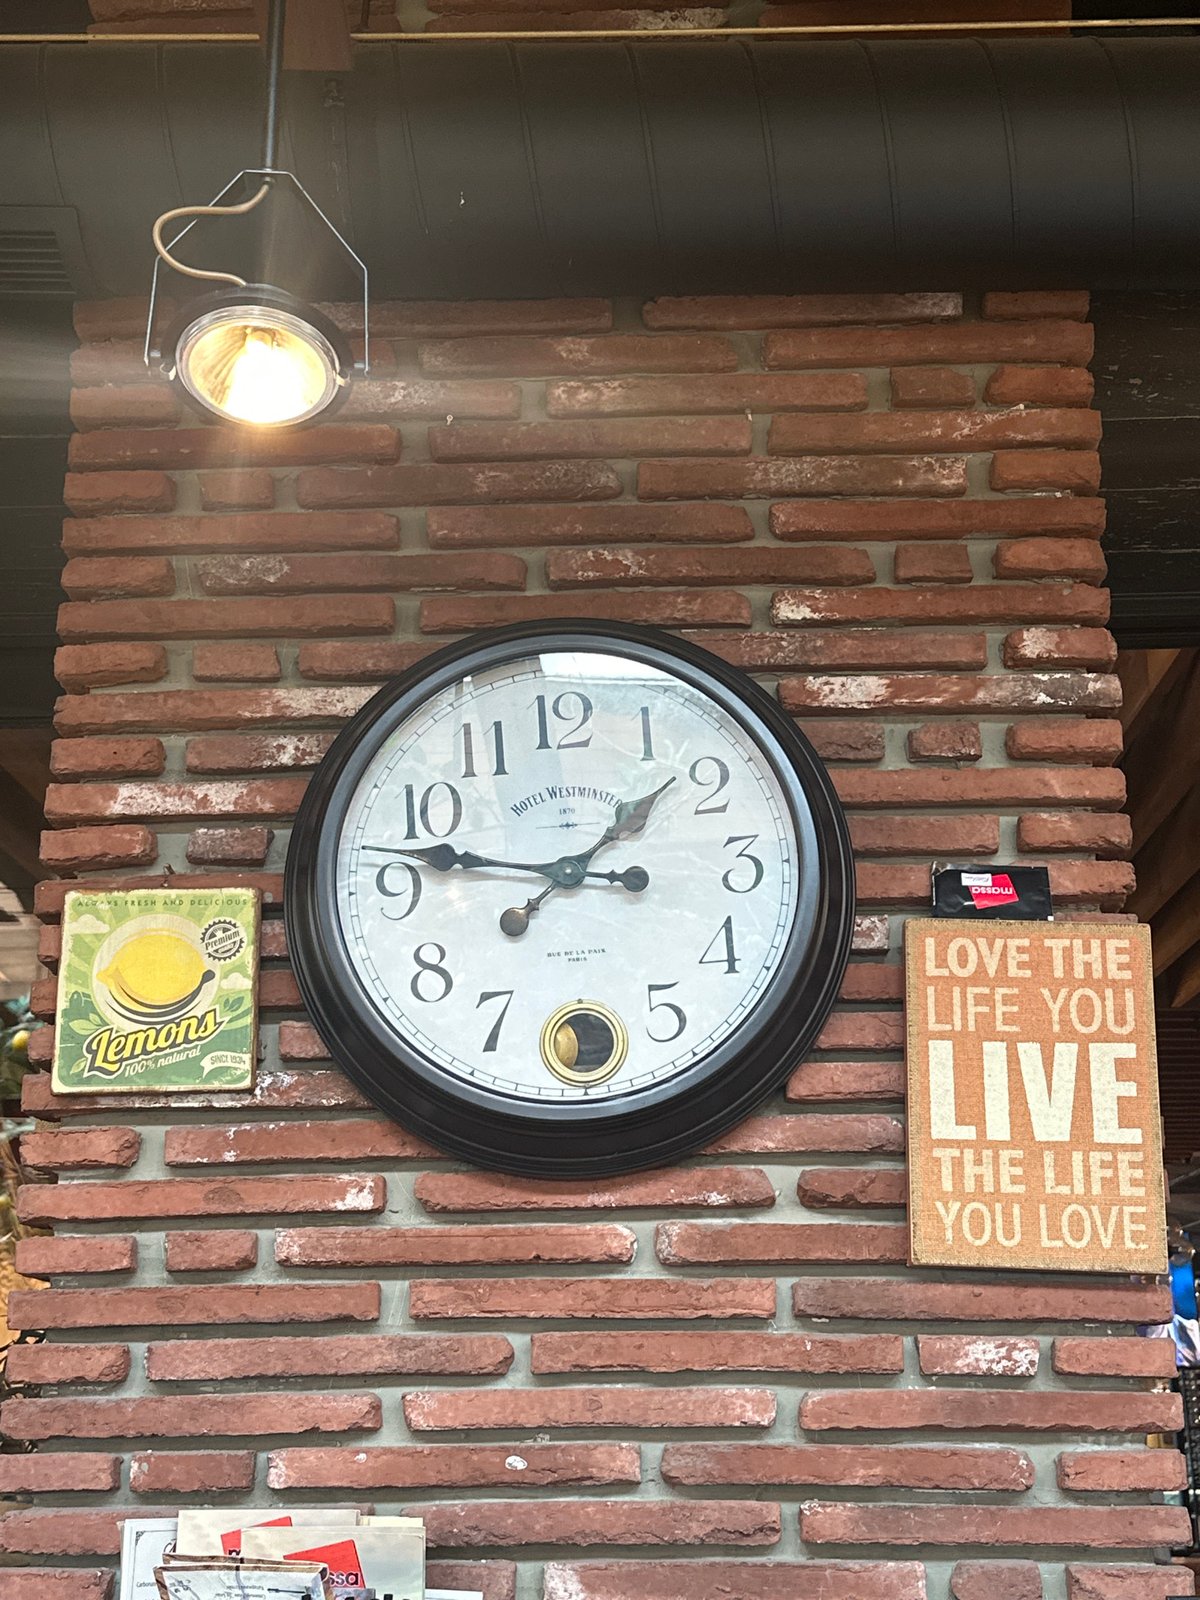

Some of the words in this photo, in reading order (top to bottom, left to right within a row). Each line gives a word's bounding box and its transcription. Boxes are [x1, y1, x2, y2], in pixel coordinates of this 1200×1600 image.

[525, 690, 594, 750] 12
[632, 706, 655, 761] 1
[457, 720, 510, 778] 11
[397, 782, 463, 840] 10
[510, 792, 547, 817] HOTEL
[545, 785, 623, 808] WESTMINSTER
[559, 807, 576, 815] 1870
[688, 756, 730, 815] 2
[376, 861, 422, 921] 9
[721, 834, 764, 893] 3
[971, 886, 1014, 895] massa
[124, 899, 157, 907] FRESH
[190, 898, 248, 906] DELICIOUS
[204, 929, 240, 951] Premium
[698, 915, 742, 974] 4
[925, 937, 1032, 978] LOVE
[1043, 938, 1132, 980] THE
[410, 942, 454, 1002] 8
[475, 990, 515, 1052] 7
[646, 981, 687, 1042] 5
[926, 985, 1021, 1032] LIFE
[1041, 987, 1136, 1035] YOU
[88, 1008, 221, 1075] Lemons
[125, 1057, 156, 1077] 100%
[157, 1045, 202, 1069] natural
[927, 1040, 1143, 1144] LIVE
[931, 1148, 1026, 1194] THE
[1043, 1150, 1146, 1197] LIFE
[935, 1200, 1023, 1247] YOU
[1039, 1205, 1149, 1250] LOVE
[328, 1571, 359, 1586] ssa
